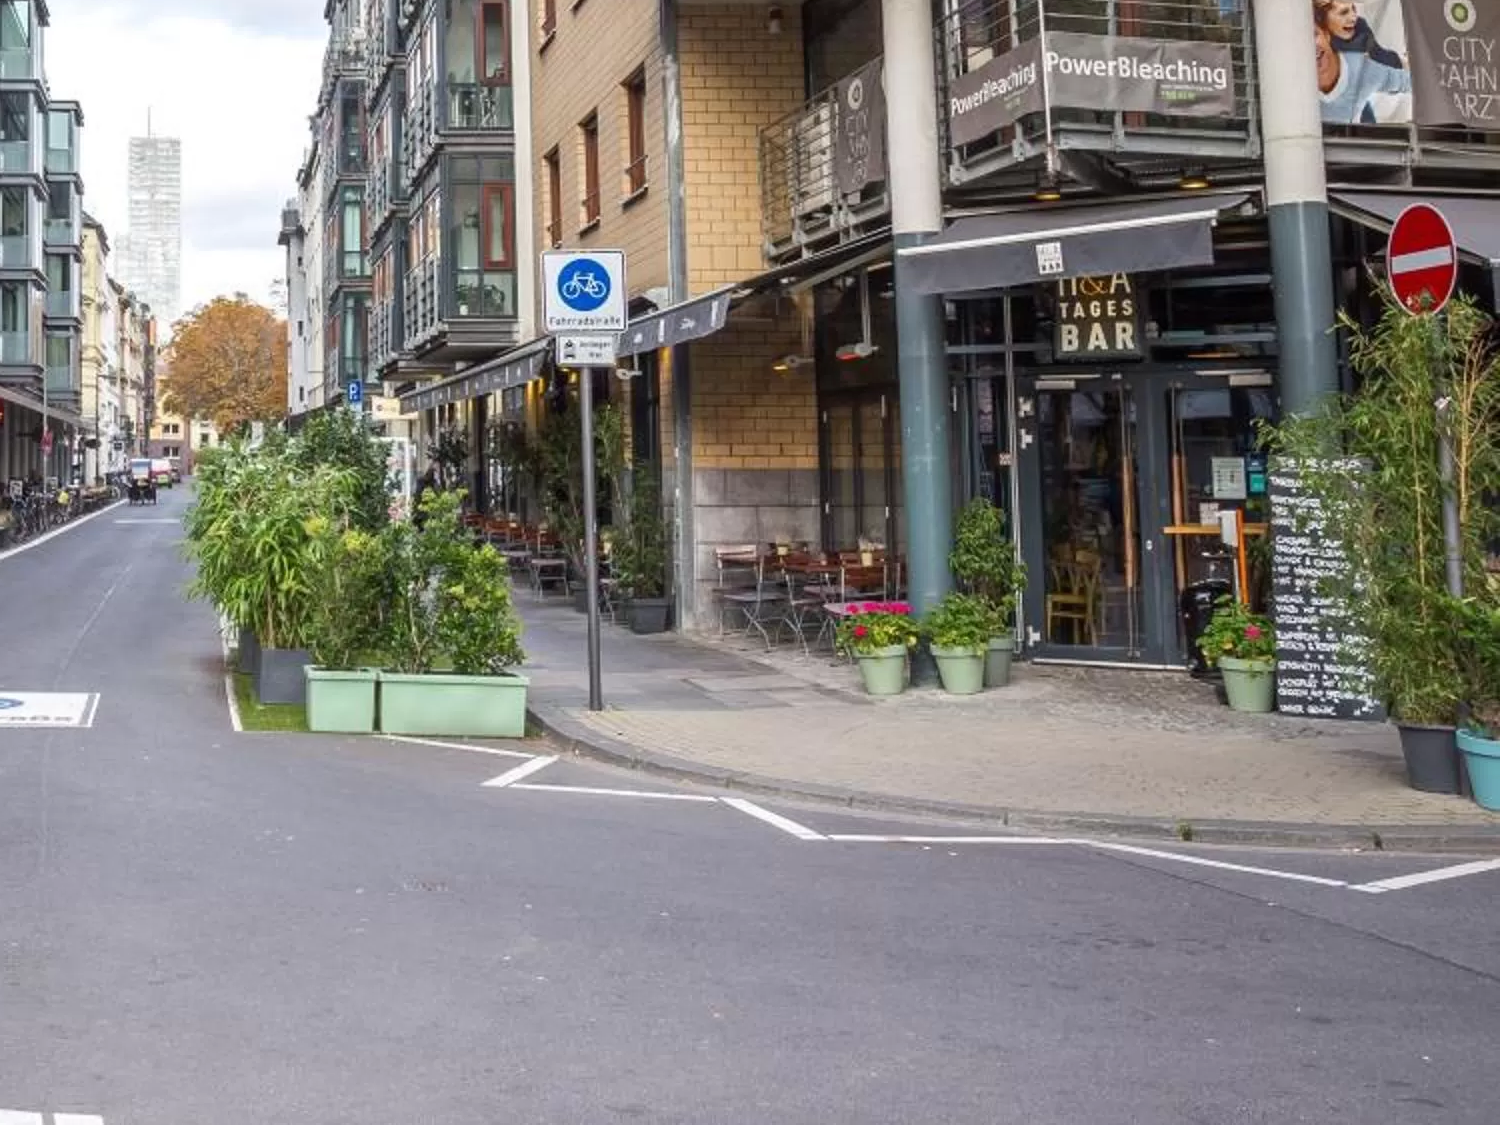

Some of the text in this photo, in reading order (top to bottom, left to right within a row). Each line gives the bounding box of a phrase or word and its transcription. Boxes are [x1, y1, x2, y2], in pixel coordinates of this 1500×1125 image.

[1443, 36, 1496, 62] CITY
[1046, 51, 1228, 90] PowerBleaching
[951, 62, 1037, 117] PowerBleaching
[1453, 92, 1500, 120] ARZ
[1060, 298, 1134, 319] TAGES
[1061, 321, 1135, 352] BAR
